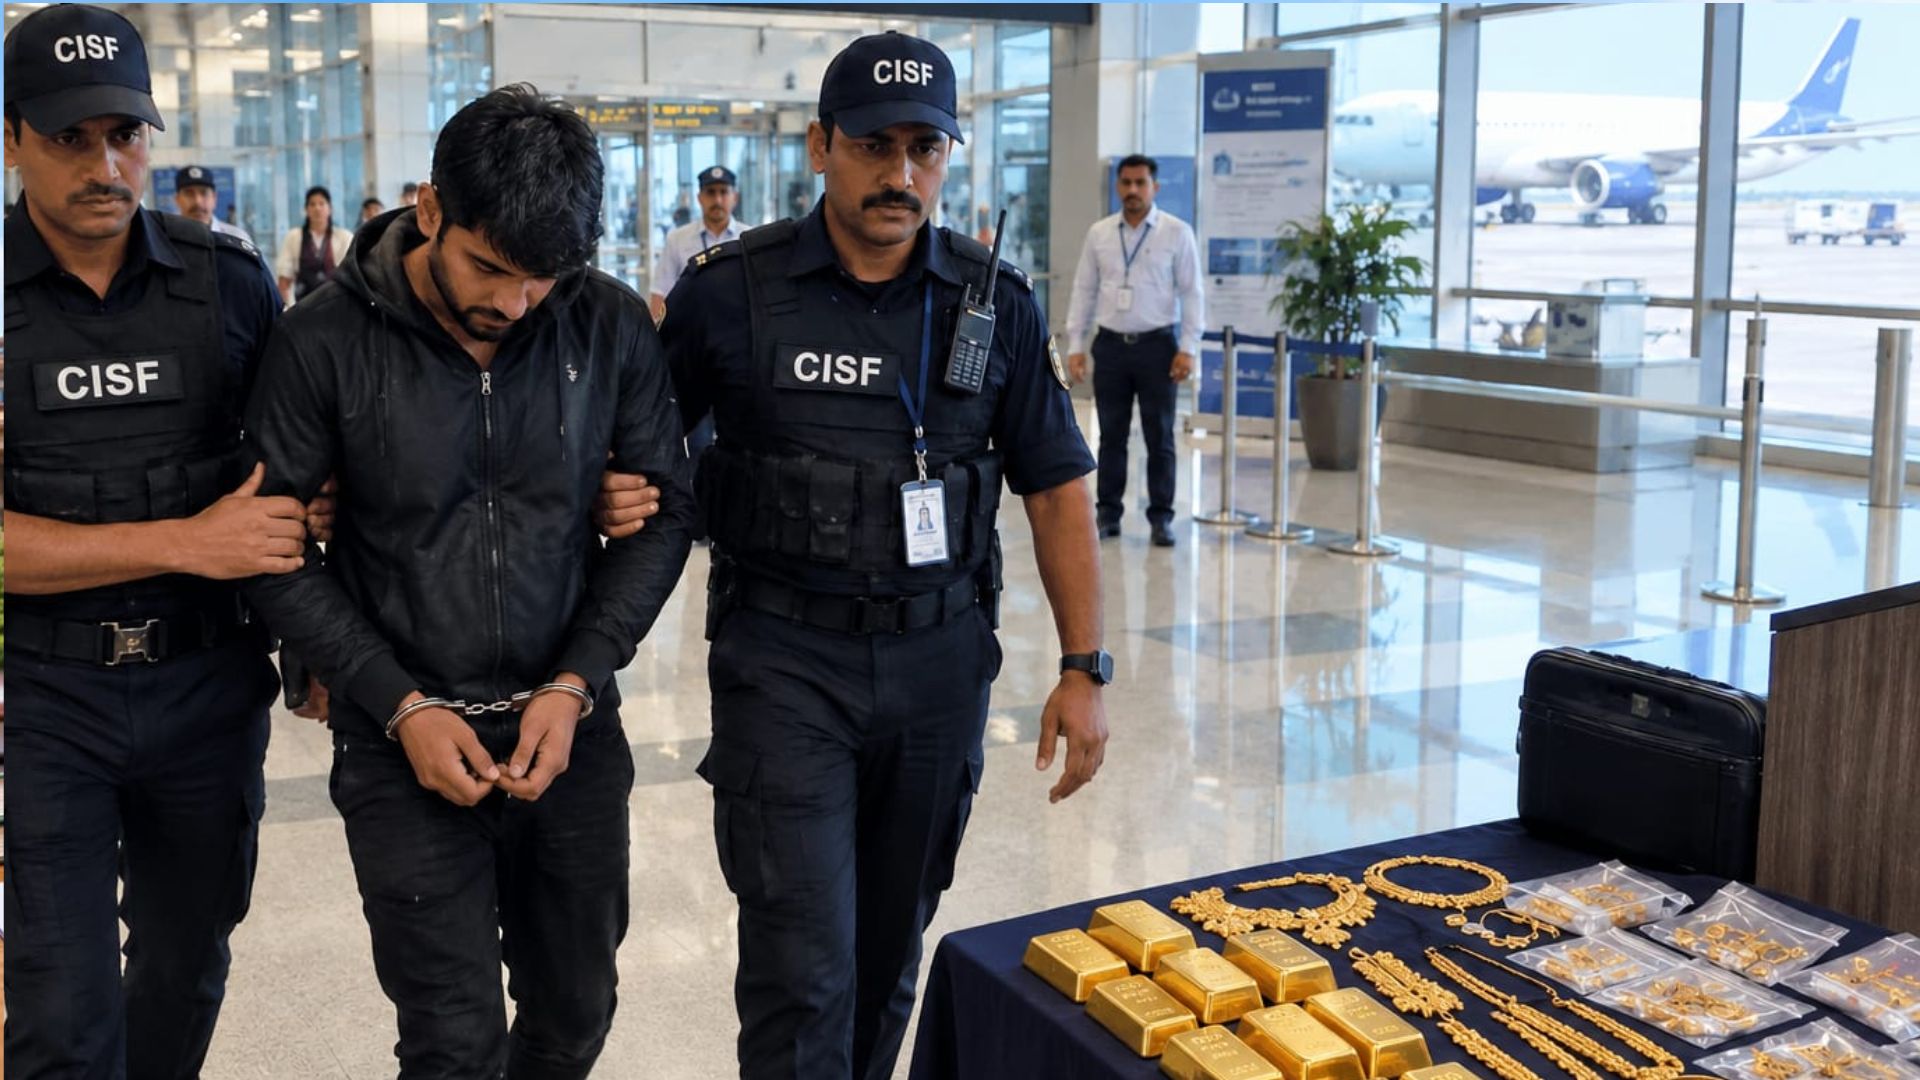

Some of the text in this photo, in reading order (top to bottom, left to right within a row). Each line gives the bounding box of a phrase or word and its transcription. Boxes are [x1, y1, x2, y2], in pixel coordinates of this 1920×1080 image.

[55, 35, 119, 62] CISF
[874, 60, 933, 86] CISF
[57, 361, 158, 399] CISF
[794, 352, 882, 386] CISF
